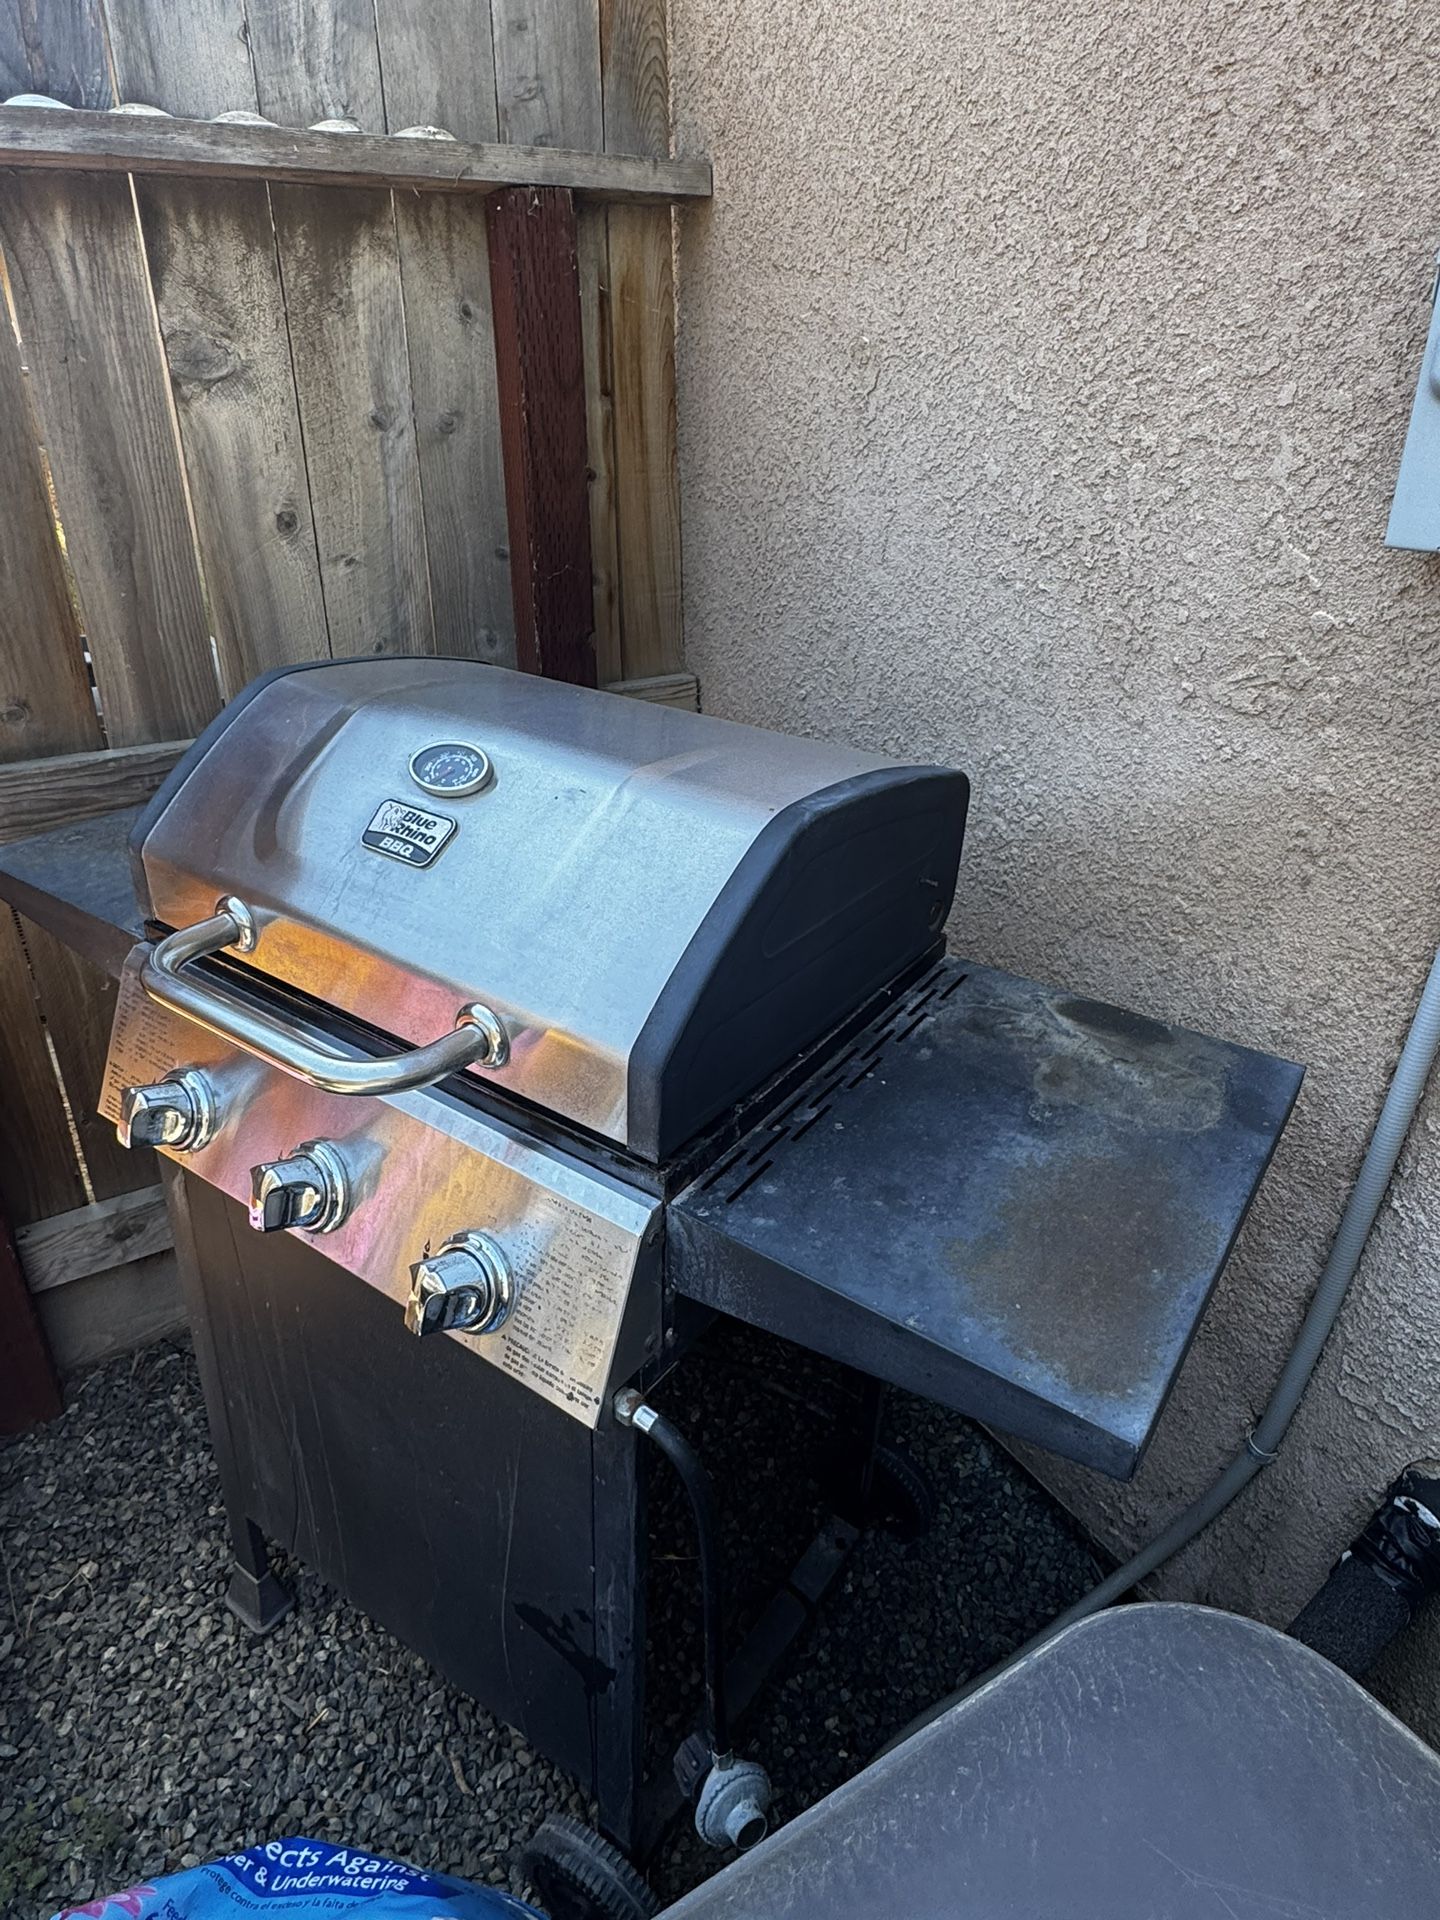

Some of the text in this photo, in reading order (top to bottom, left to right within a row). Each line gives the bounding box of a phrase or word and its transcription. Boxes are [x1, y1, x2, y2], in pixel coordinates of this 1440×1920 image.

[403, 811, 438, 830] Blue
[390, 822, 437, 845] Rhino
[379, 836, 415, 858] BBQ
[324, 1849, 432, 1882] Against
[254, 1866, 268, 1887] &
[271, 1870, 410, 1892] Underwatering
[230, 1891, 260, 1910] contra
[322, 1897, 345, 1910] falta
